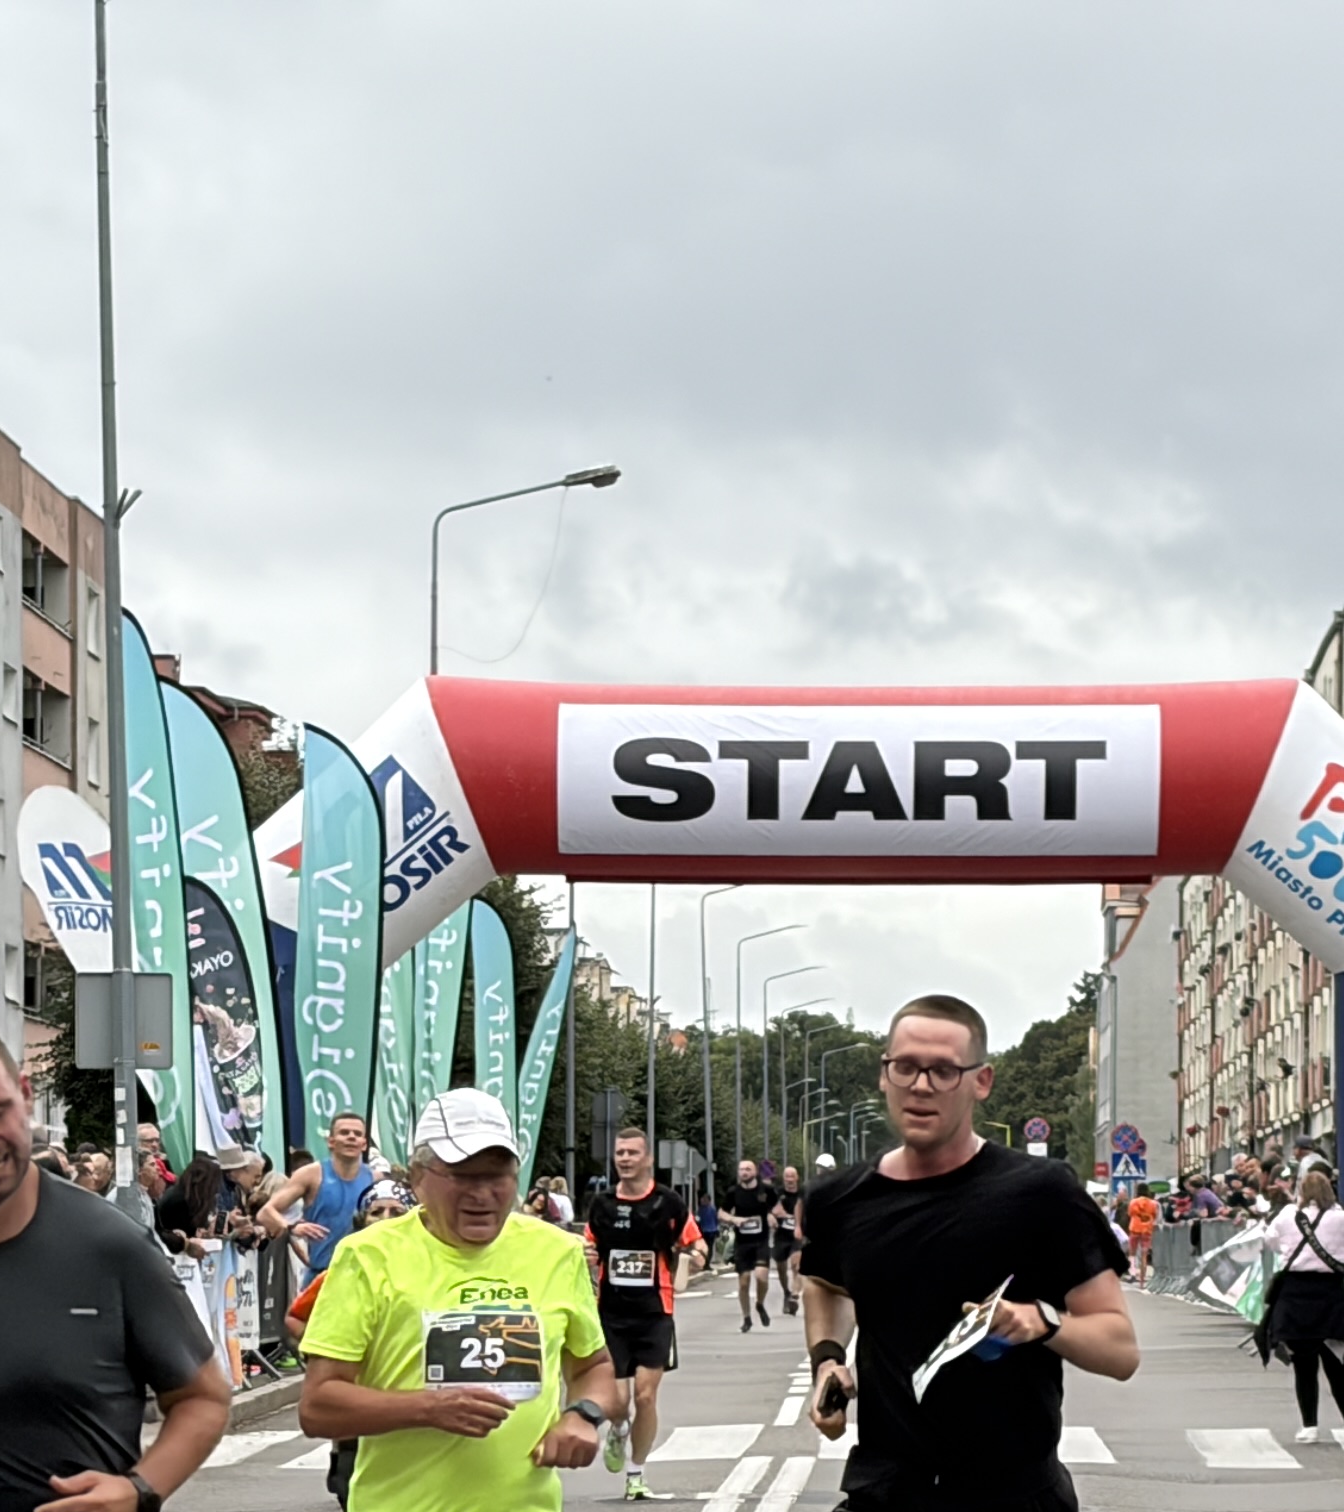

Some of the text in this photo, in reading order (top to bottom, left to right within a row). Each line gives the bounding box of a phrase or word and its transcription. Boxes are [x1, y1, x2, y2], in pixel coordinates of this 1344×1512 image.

[611, 737, 1108, 822] START
[383, 825, 471, 912] OSiR
[1245, 840, 1323, 911] Miasto
[616, 1261, 644, 1275] 237
[460, 1286, 529, 1305] Enea
[460, 1337, 507, 1369] 25
